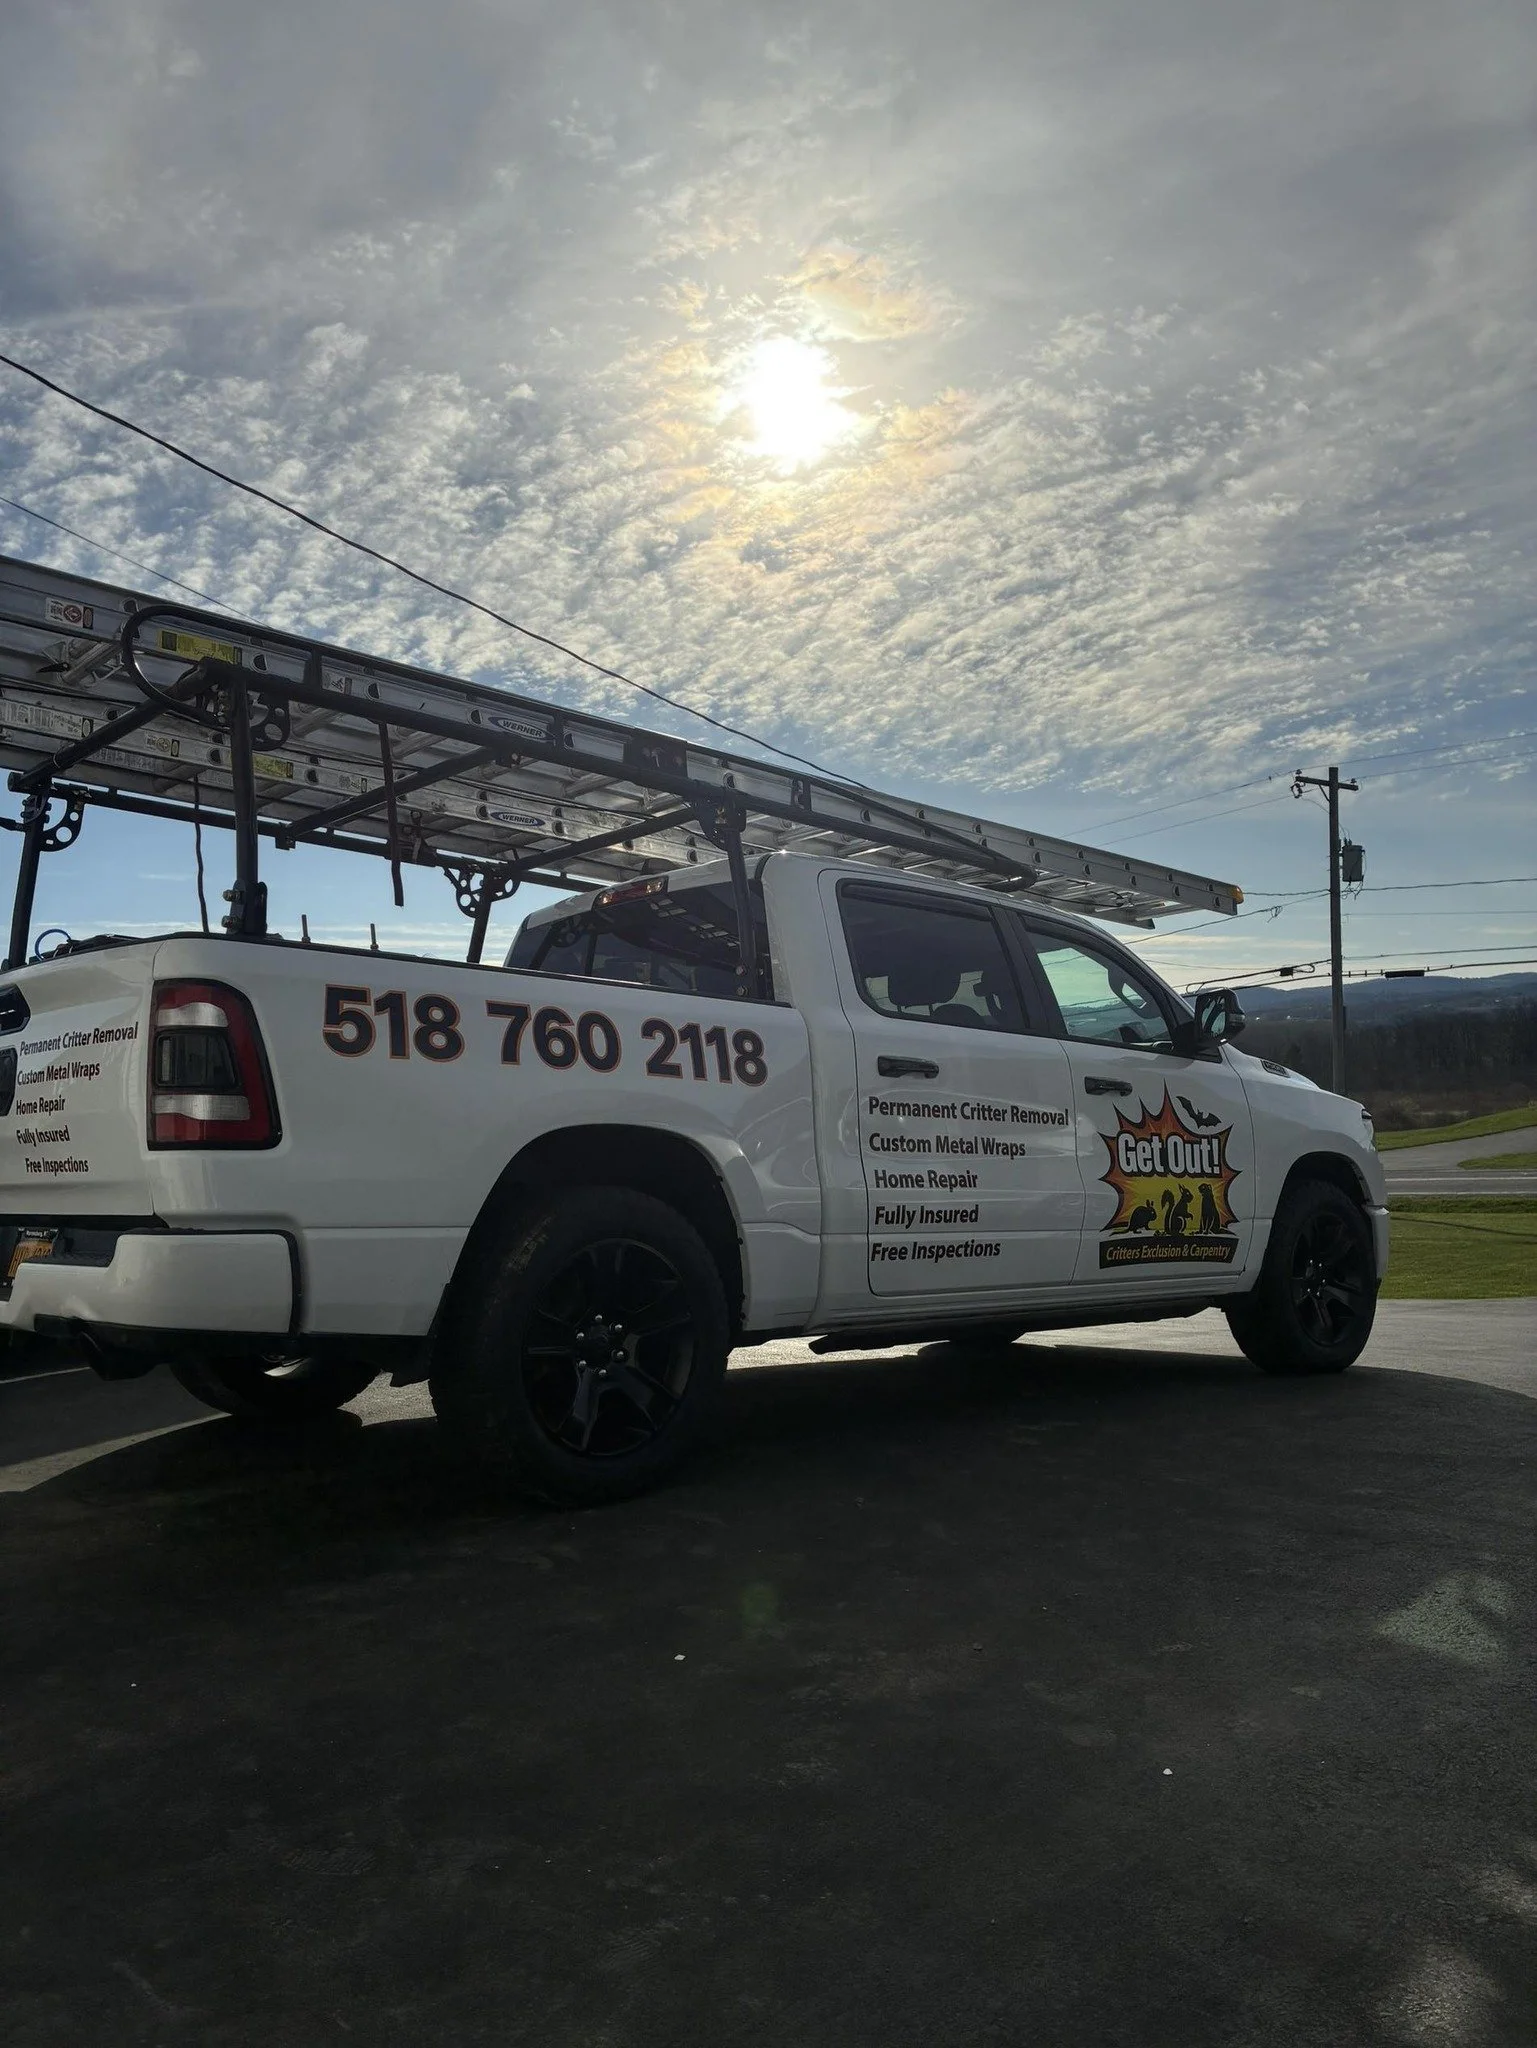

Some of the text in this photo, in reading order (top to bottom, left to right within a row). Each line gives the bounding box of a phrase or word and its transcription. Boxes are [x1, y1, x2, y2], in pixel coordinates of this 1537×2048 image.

[503, 720, 542, 737] WERNER
[502, 814, 535, 824] WERNER
[19, 1021, 139, 1056] Permanent Critter Removal
[321, 983, 769, 1088] 518 760 2118
[17, 1061, 100, 1085] Custom Metal Wraps
[16, 1094, 66, 1116] Home Repair
[868, 1096, 1070, 1126] Permanent Critter Removal
[16, 1125, 70, 1147] Fully Insured
[869, 1132, 1027, 1160] Custom Metal Wraps
[1117, 1132, 1221, 1176] Get Out!
[25, 1156, 89, 1177] Free Inspections
[874, 1169, 979, 1192] Home Repair
[874, 1204, 979, 1229] Fully Insured
[870, 1239, 1001, 1263] Free Inspections
[1106, 1244, 1231, 1261] Critters Exclusion & Carpentry
